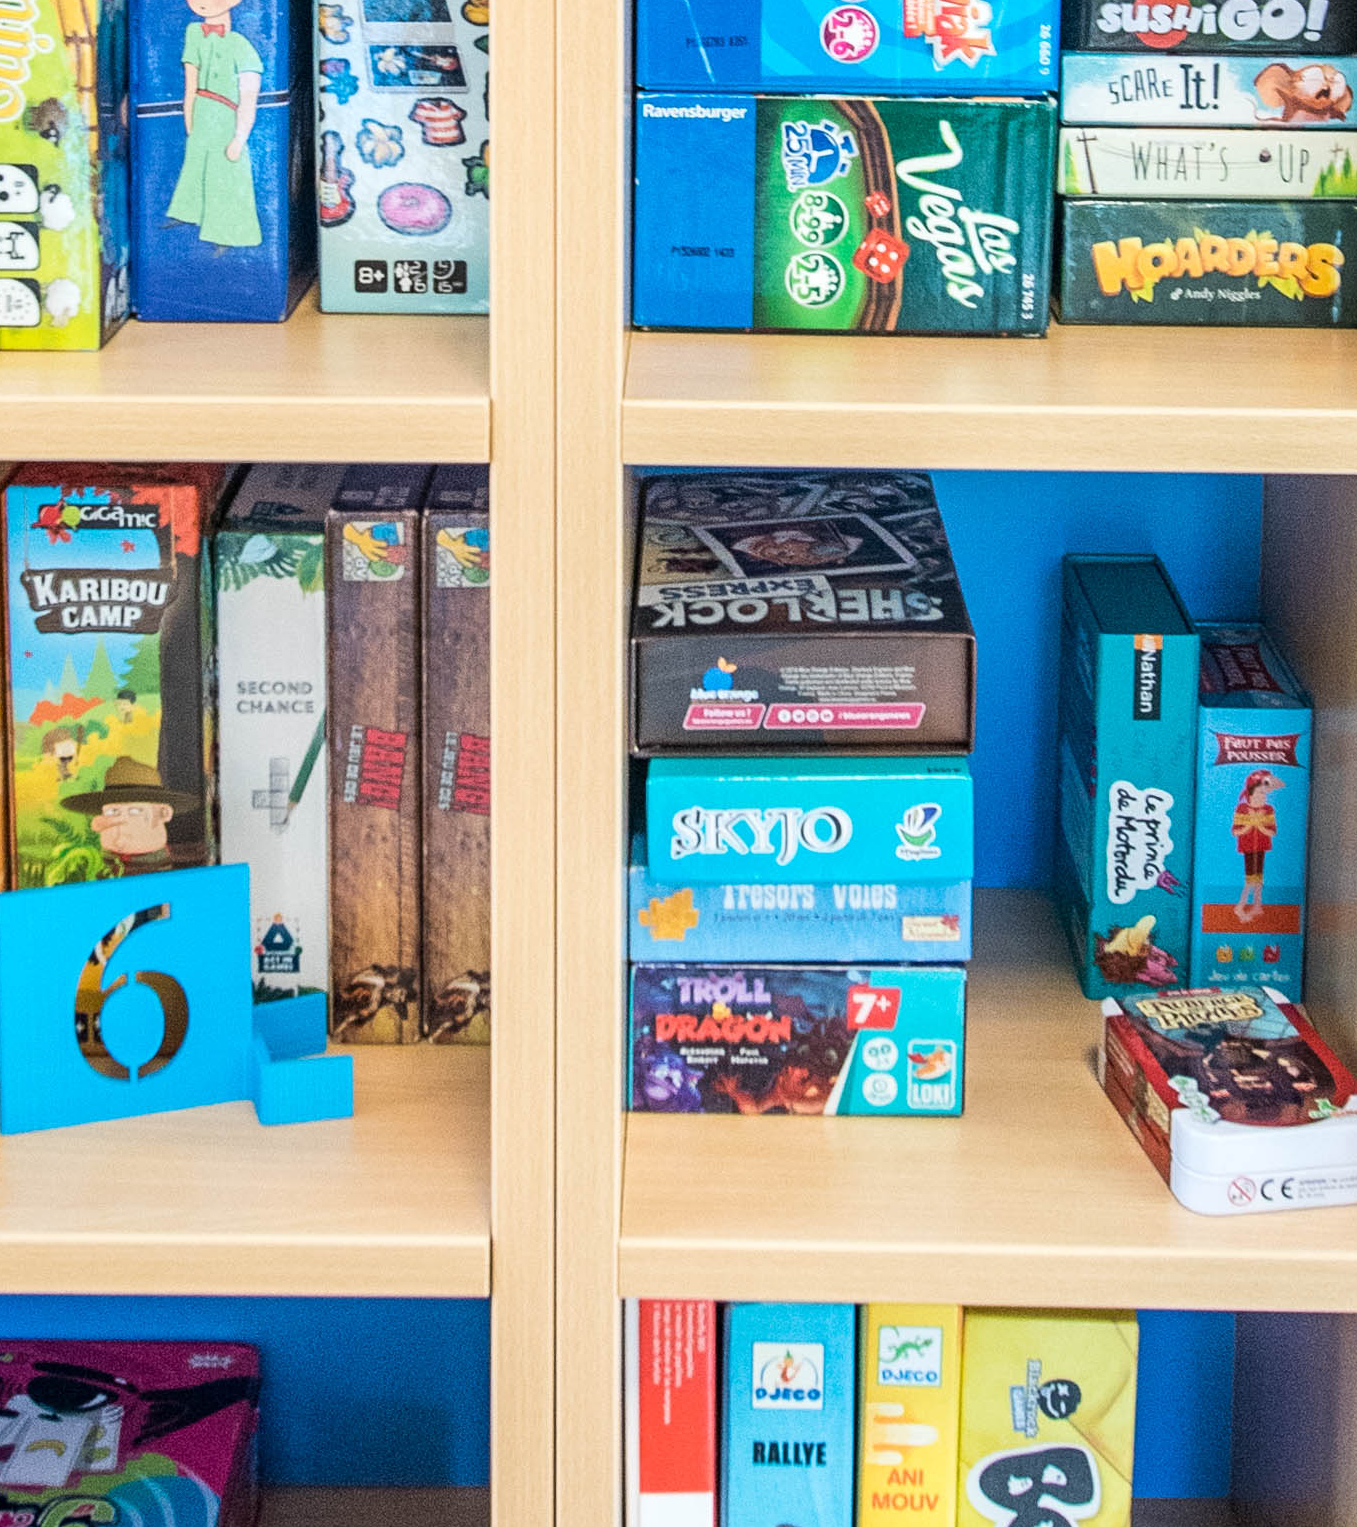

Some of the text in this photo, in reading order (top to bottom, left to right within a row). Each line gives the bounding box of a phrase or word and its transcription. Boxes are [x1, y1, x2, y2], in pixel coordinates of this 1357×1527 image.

[641, 101, 748, 124] Ravensburger
[1130, 142, 1312, 185] WHAT'S UP
[1090, 235, 1346, 298] HOARDERS
[1183, 286, 1262, 304] Andy Niggles
[29, 571, 172, 609] KARIBOU
[59, 604, 144, 629] CAMP
[649, 588, 945, 630] SHERLOCK
[235, 680, 315, 698] SECOND
[1139, 642, 1156, 715] Nathan
[235, 698, 316, 716] CHANCE
[669, 806, 854, 861] SKYJO
[73, 902, 191, 1084] 6
[676, 977, 771, 1009] TROLL
[654, 1012, 793, 1045] DRAGON
[881, 1369, 939, 1383] DJECO
[755, 1387, 822, 1403] DJECO
[752, 1441, 828, 1467] RALLYE
[886, 1468, 925, 1487] ANI
[871, 1491, 940, 1512] MOUV
